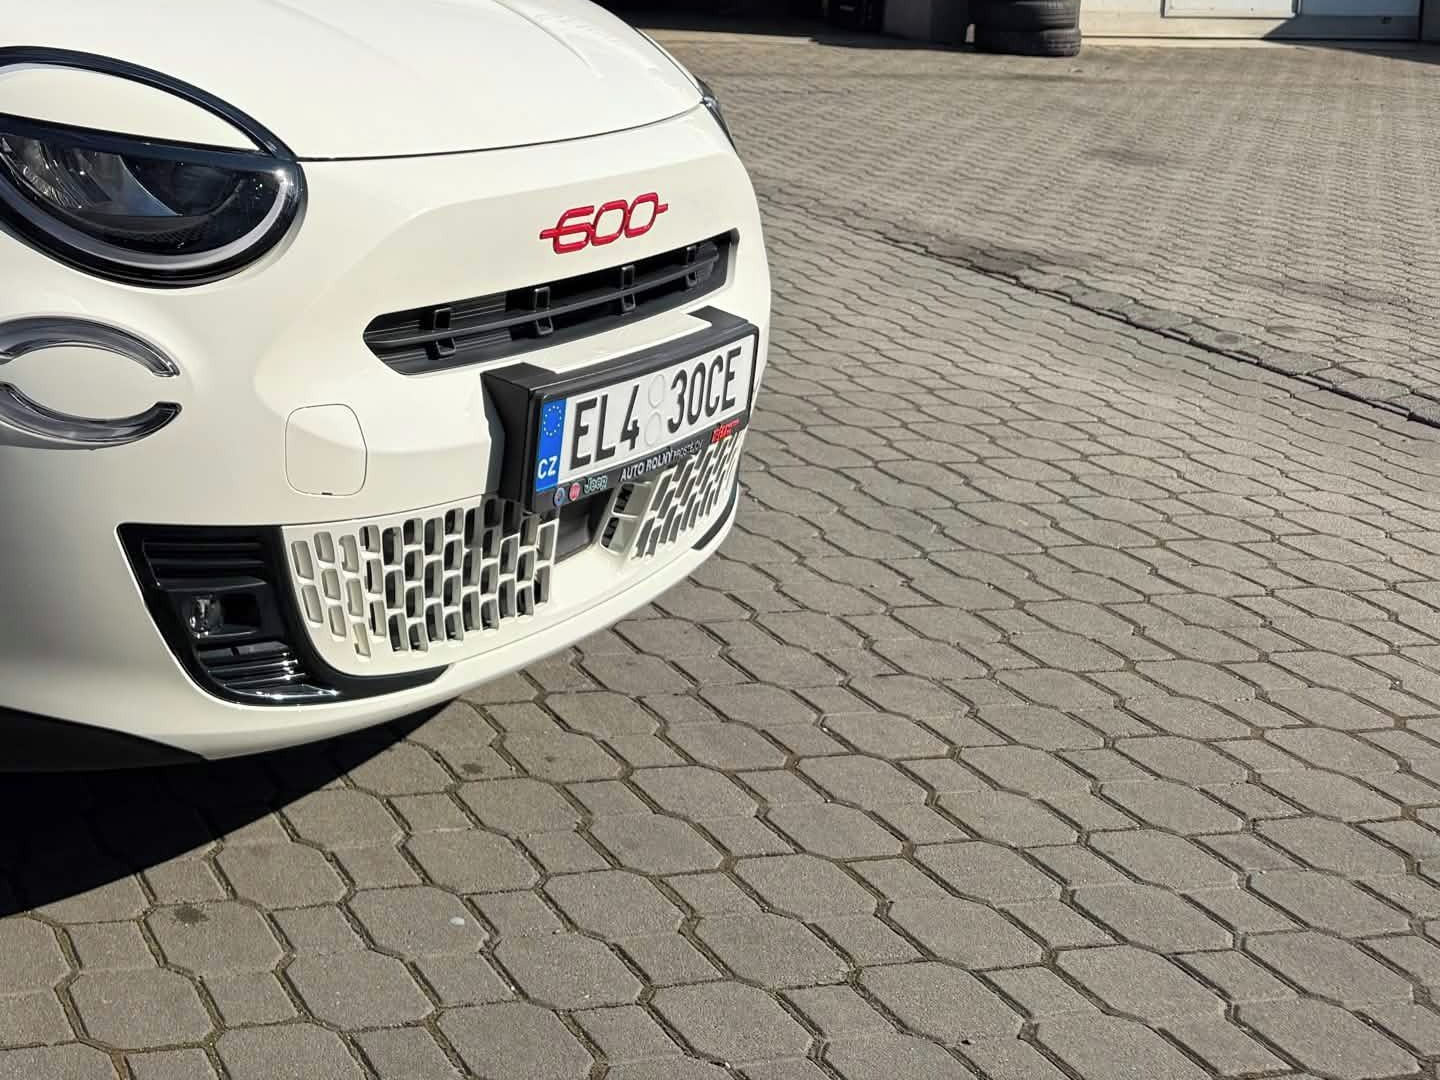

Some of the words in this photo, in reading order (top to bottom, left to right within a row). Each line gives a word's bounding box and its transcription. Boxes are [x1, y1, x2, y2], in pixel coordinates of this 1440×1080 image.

[540, 192, 668, 254] 600
[569, 384, 640, 470] EL4
[667, 346, 742, 434] 30CE
[537, 455, 558, 480] CZ
[620, 463, 644, 482] AUTO
